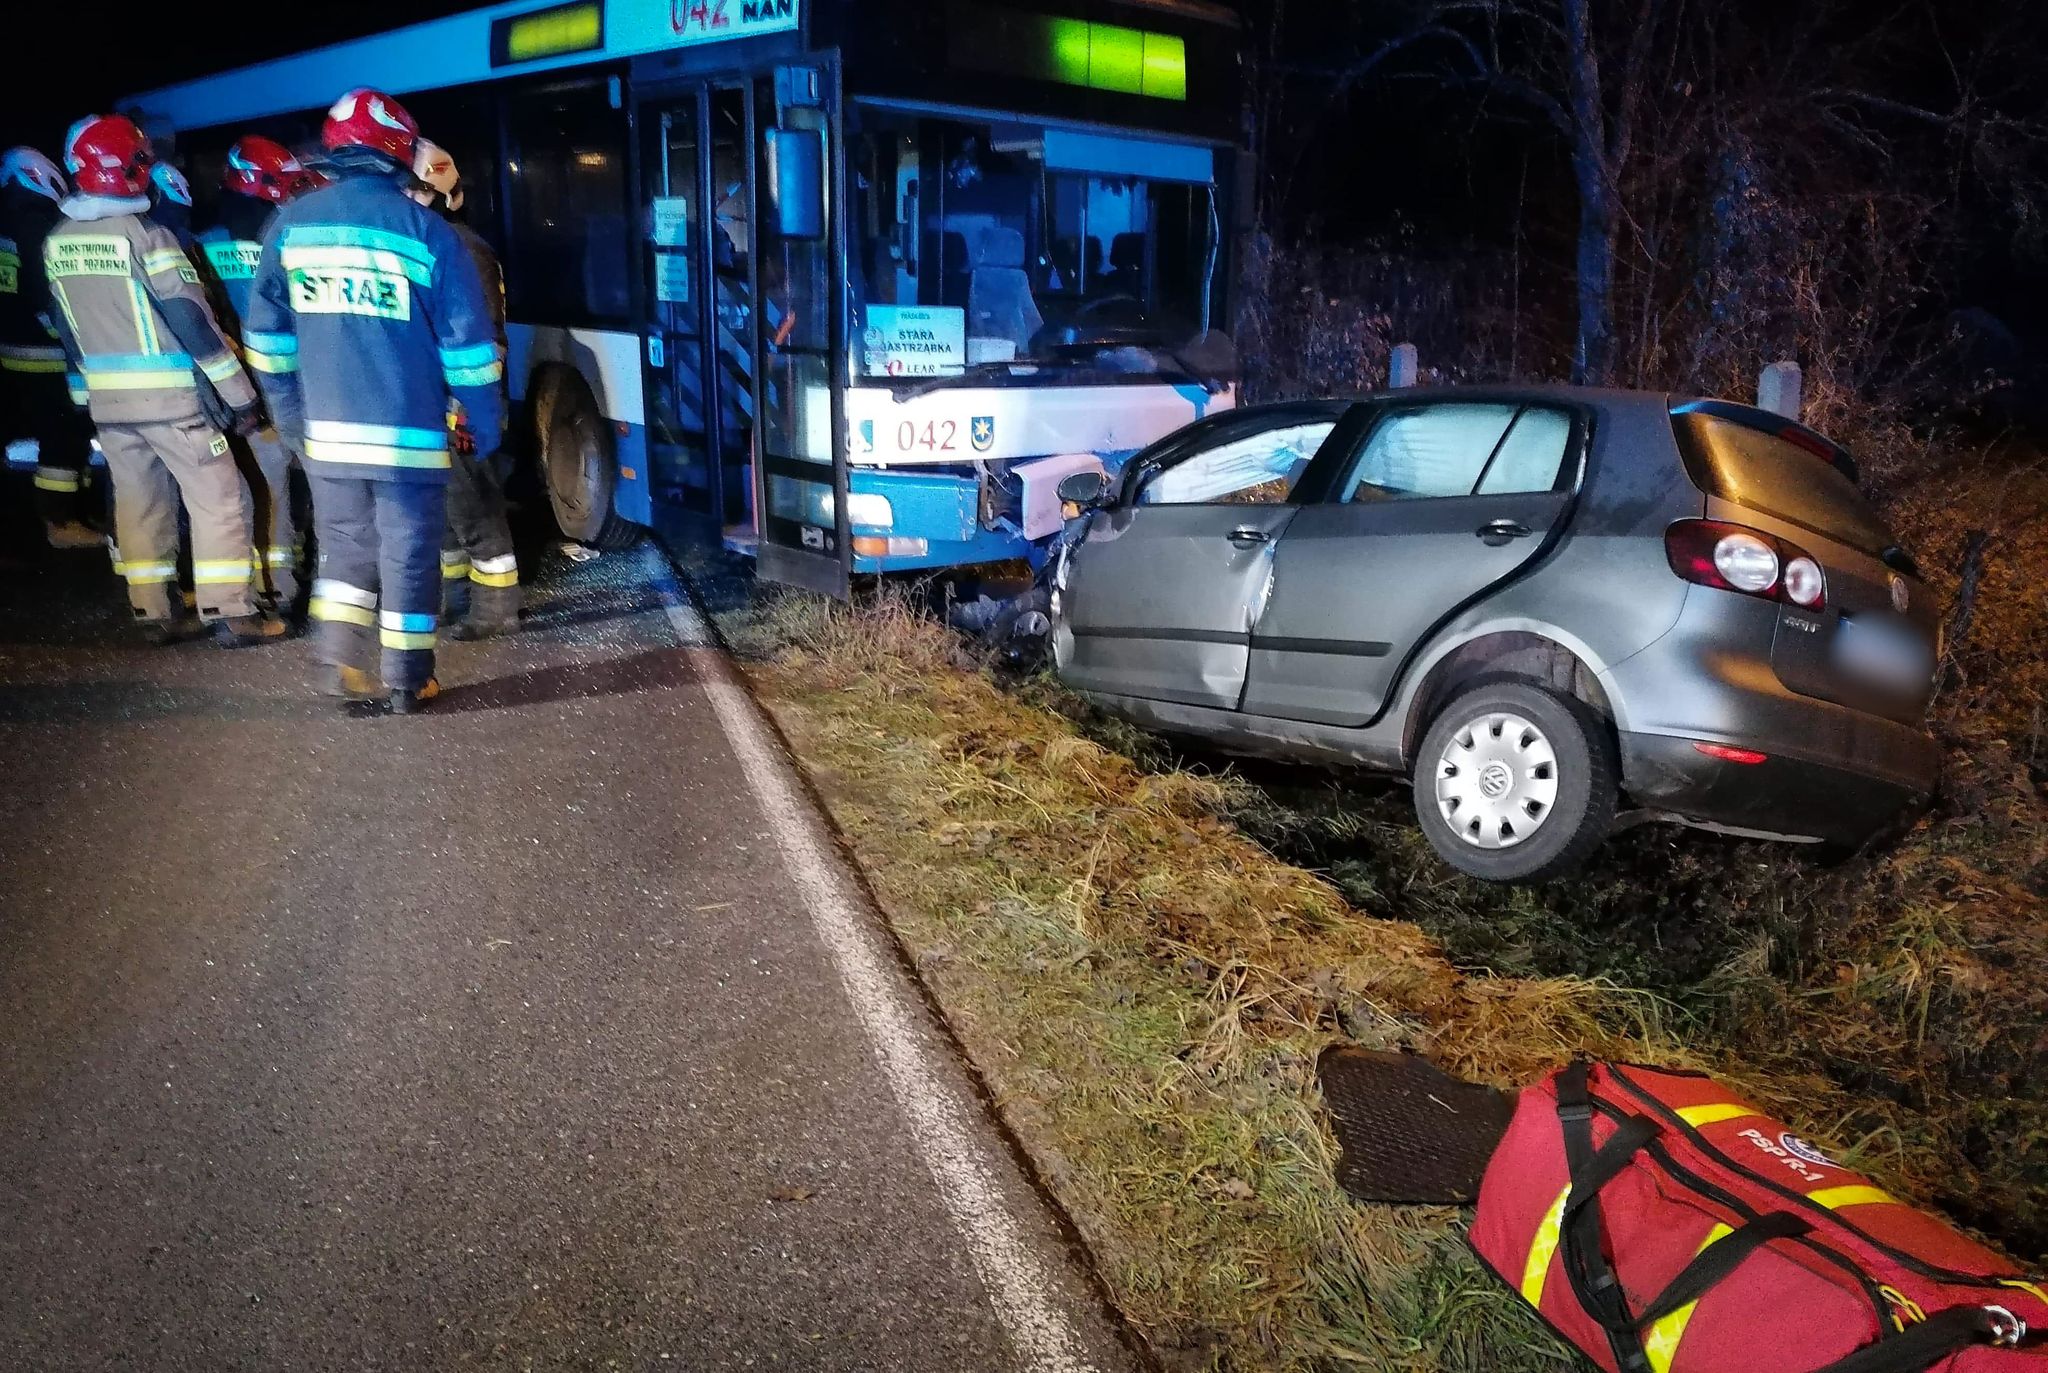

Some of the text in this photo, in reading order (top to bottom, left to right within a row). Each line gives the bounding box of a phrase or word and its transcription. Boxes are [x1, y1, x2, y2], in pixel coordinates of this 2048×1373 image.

[899, 329, 935, 341] STARA
[907, 363, 935, 374] LEAR
[898, 420, 956, 451] 042
[1736, 1128, 1788, 1157] PSP
[1780, 1158, 1825, 1182] R-1
